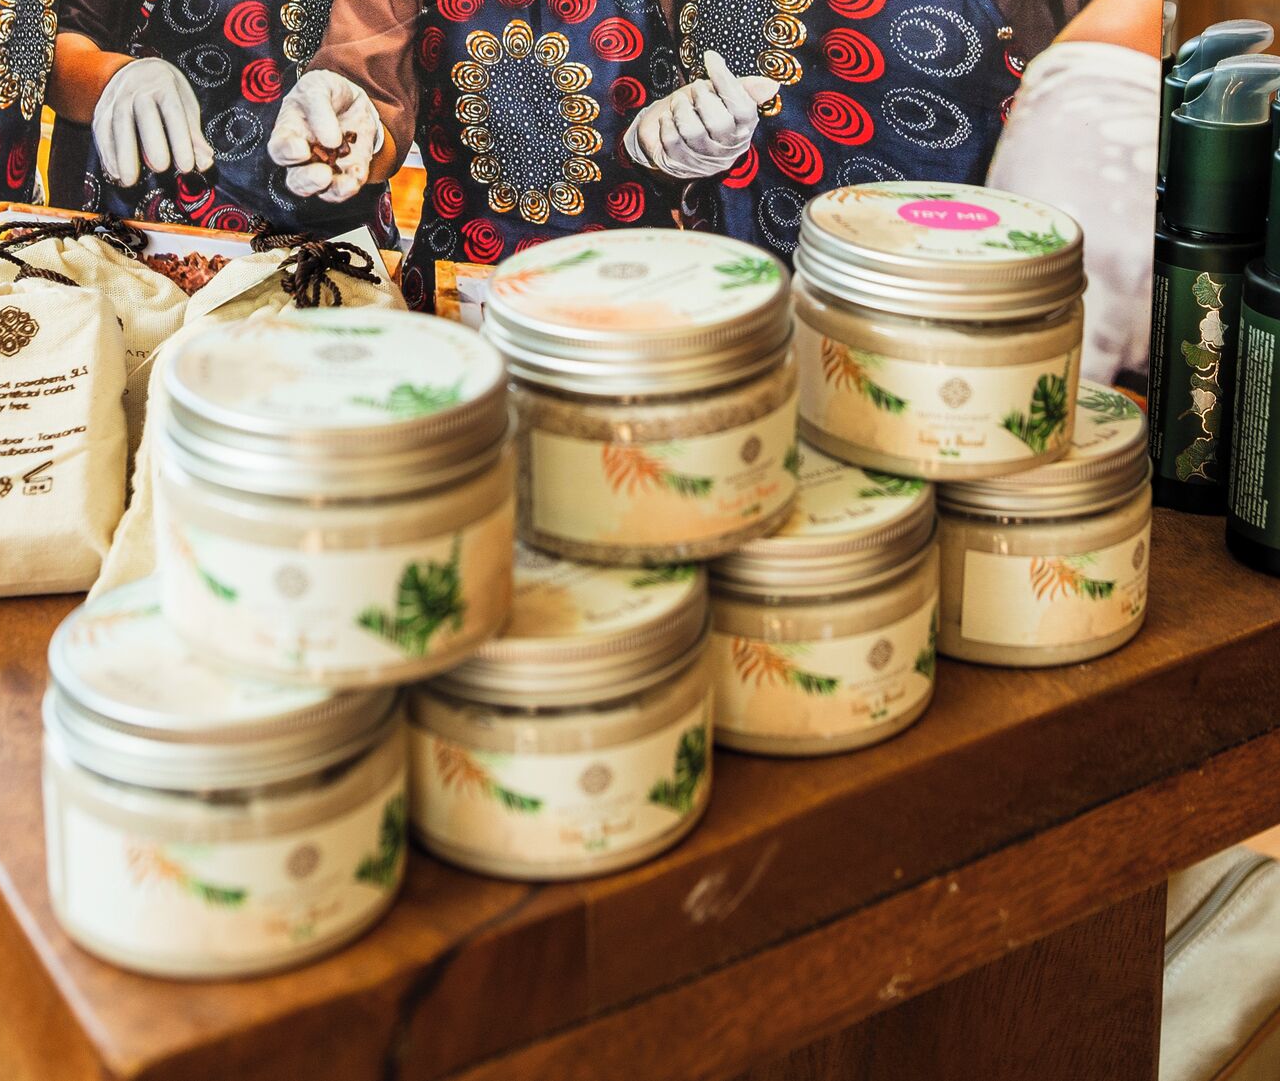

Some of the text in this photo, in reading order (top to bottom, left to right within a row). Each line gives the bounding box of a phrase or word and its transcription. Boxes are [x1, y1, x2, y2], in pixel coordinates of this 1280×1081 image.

[910, 208, 988, 222] TRY ME
[38, 425, 87, 441] Tanzania
